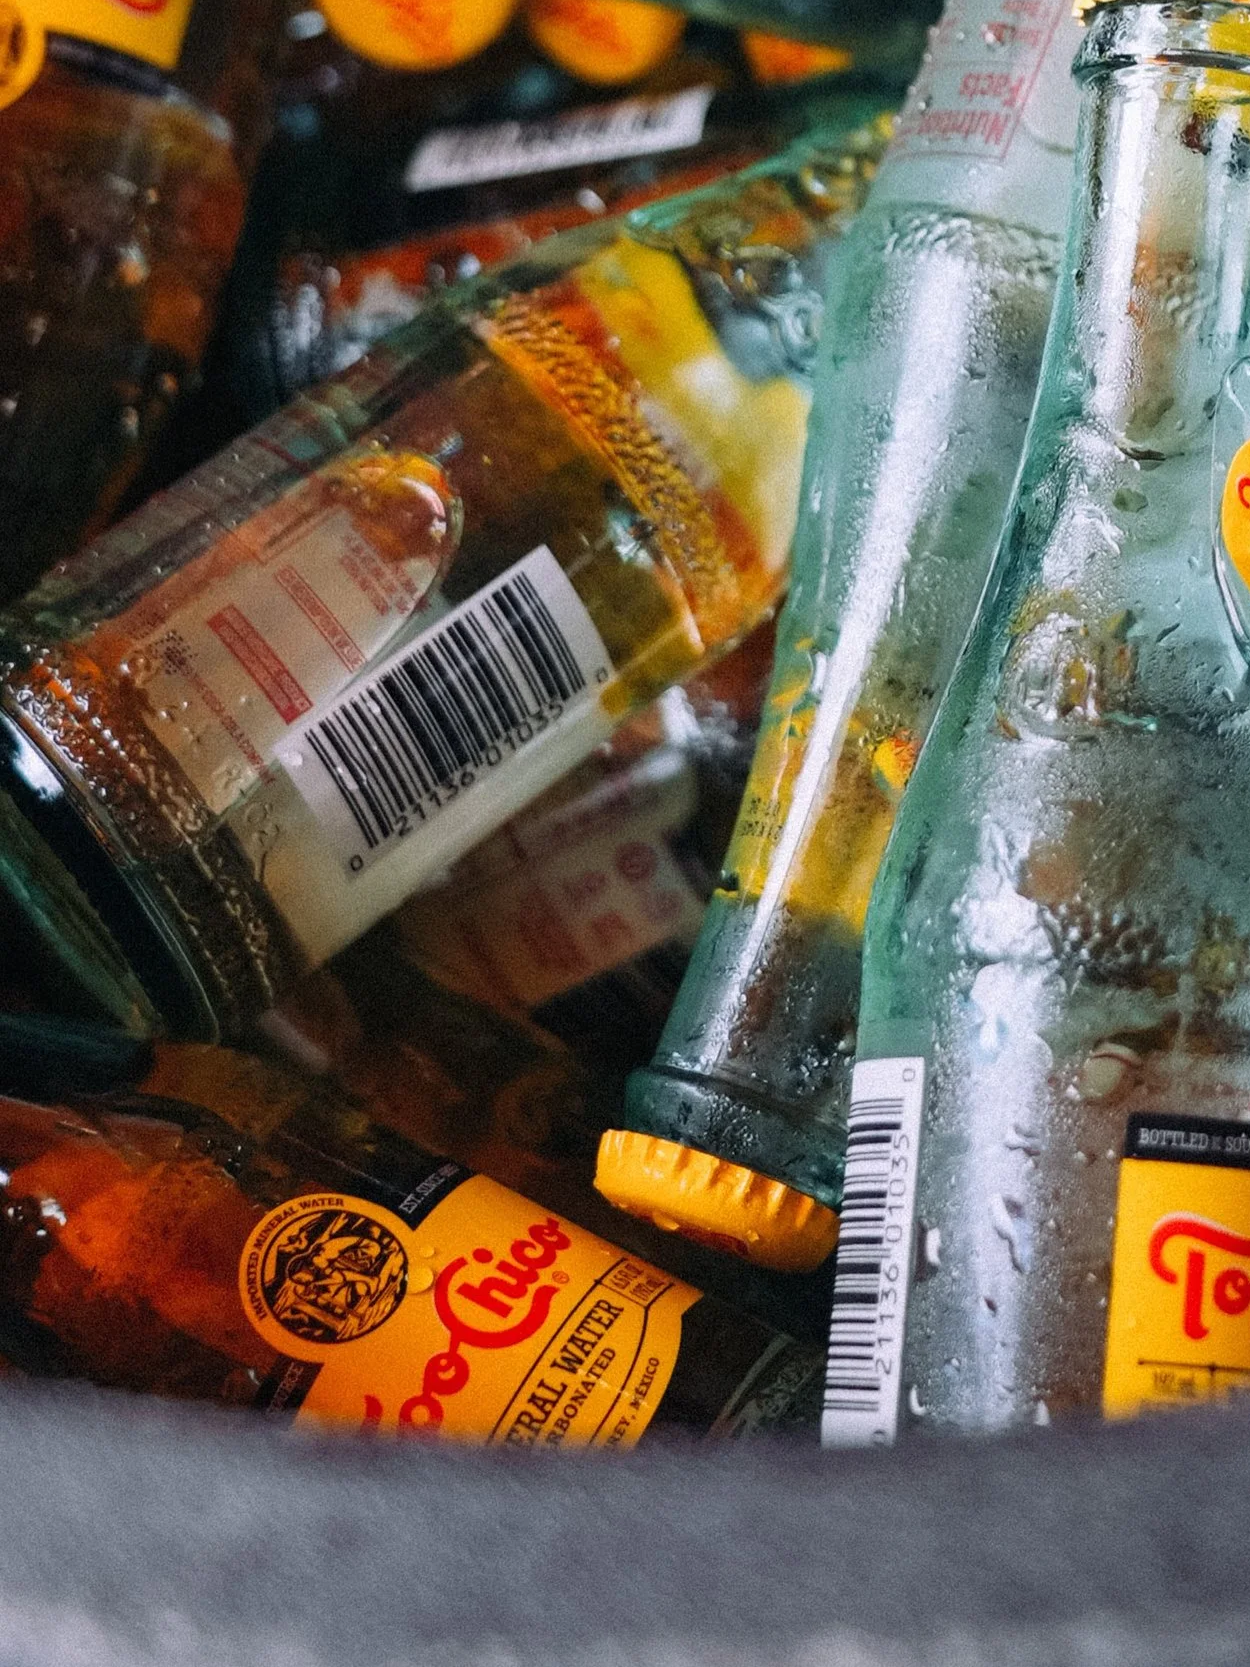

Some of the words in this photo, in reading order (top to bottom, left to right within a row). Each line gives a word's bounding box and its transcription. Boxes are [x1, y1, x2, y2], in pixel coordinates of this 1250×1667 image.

[1139, 1128, 1209, 1151] BOTTLED
[256, 1205, 297, 1249] MINERAL
[298, 1197, 344, 1211] WATER
[246, 1252, 268, 1322] IMPORTED
[434, 1217, 571, 1350] Chico
[551, 1299, 625, 1376] WATER
